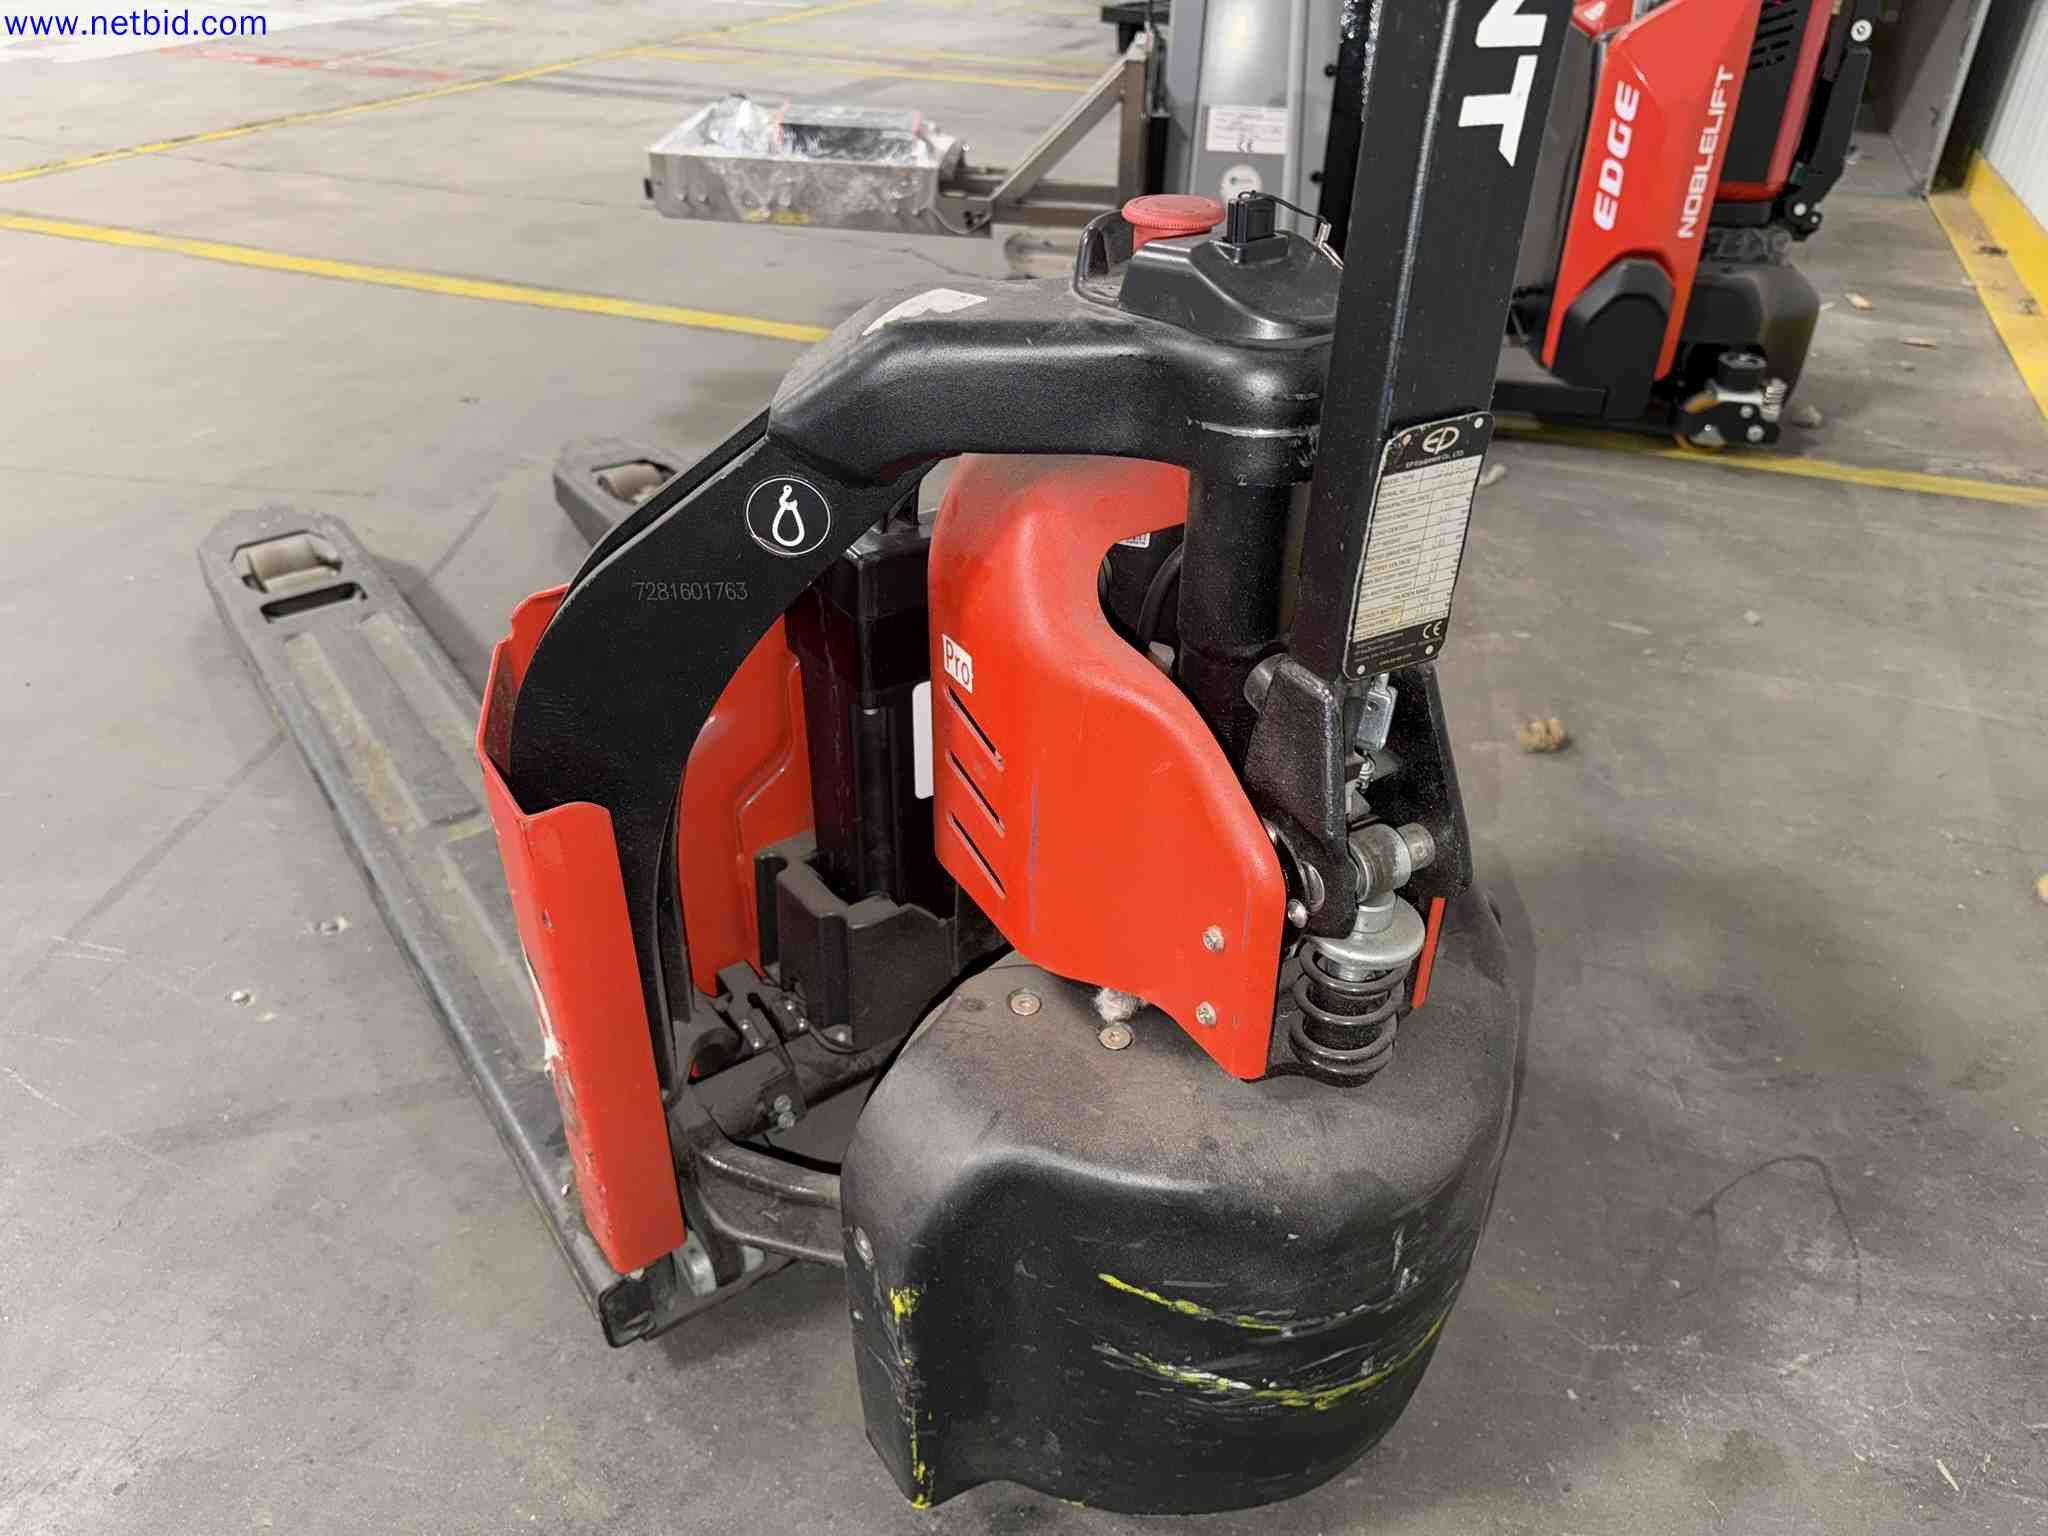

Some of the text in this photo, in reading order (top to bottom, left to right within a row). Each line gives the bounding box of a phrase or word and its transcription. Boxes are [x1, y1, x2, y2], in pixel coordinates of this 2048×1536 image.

[1593, 80, 1640, 231] EDGE
[1678, 64, 1734, 238] NOBLELIFT
[634, 581, 749, 601] 7281601763
[1421, 619, 1443, 640] CE
[945, 639, 971, 685] Pro
